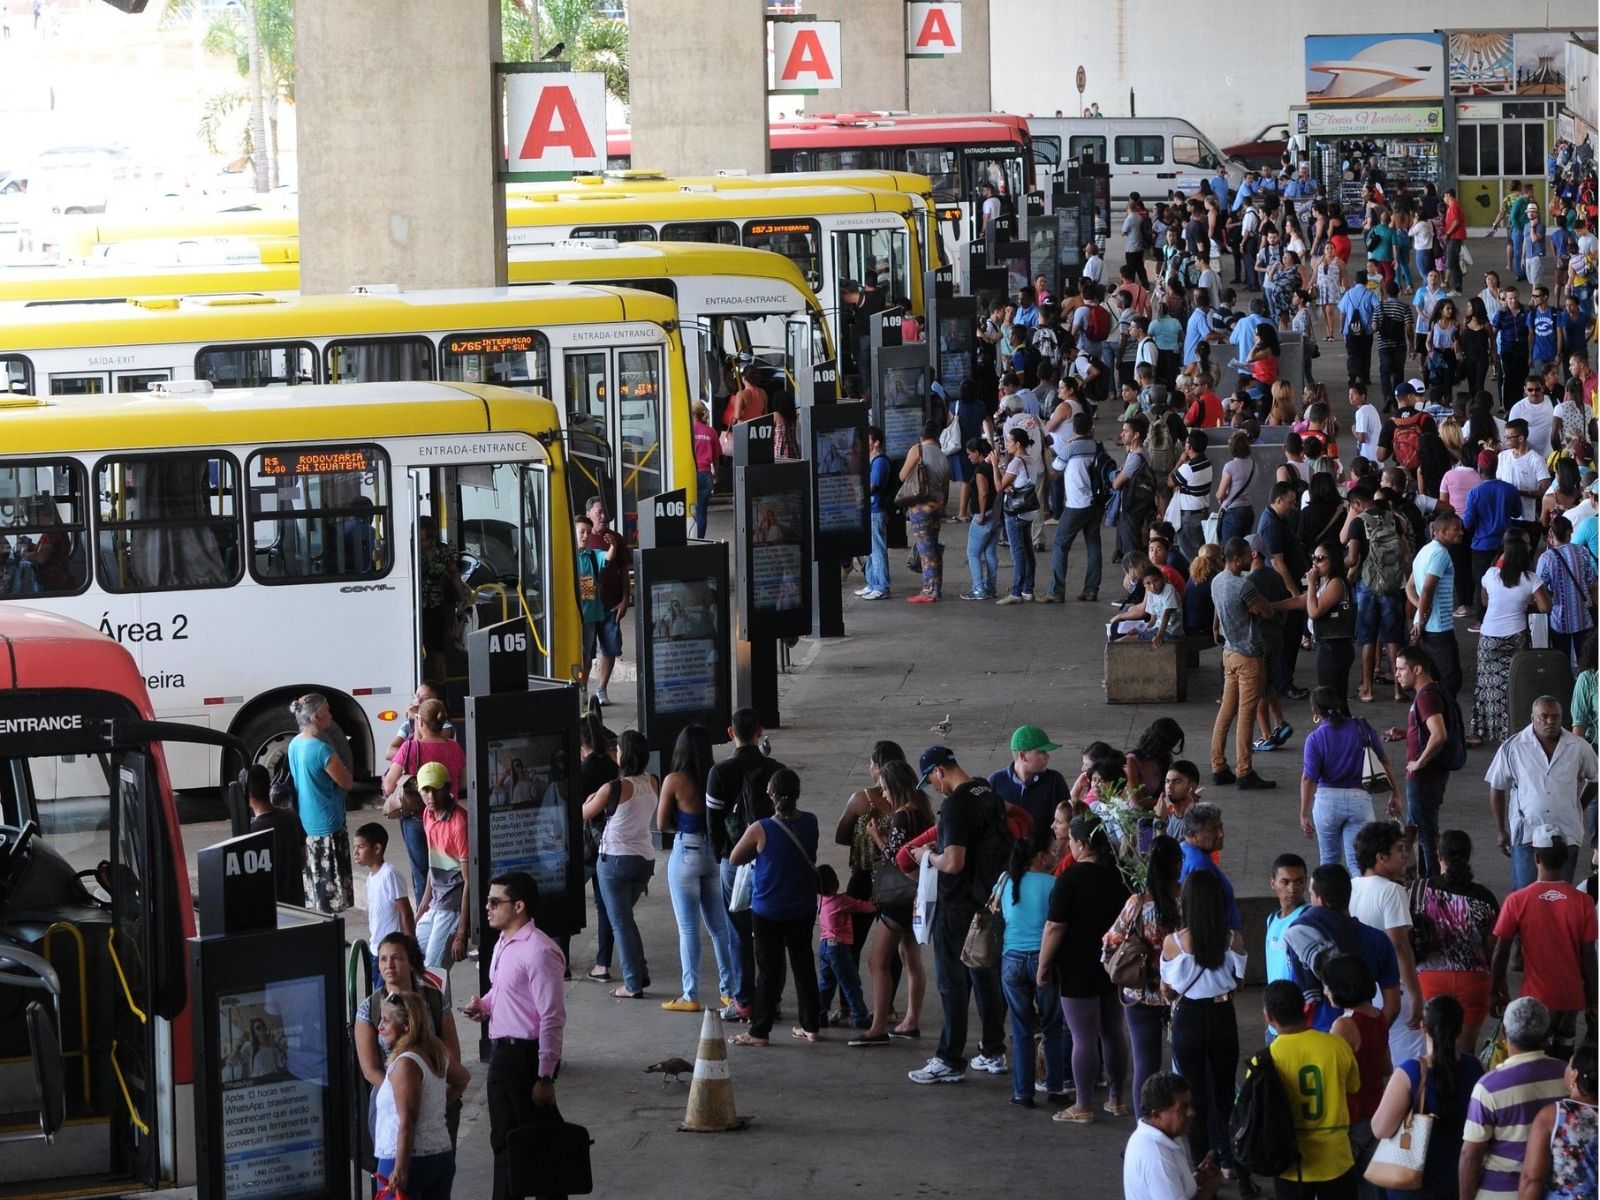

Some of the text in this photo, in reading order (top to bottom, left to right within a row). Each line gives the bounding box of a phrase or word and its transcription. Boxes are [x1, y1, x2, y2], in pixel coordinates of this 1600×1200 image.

[915, 8, 956, 47] A
[781, 29, 834, 80] A
[519, 85, 597, 160] A
[705, 295, 788, 305] ENTRADA-ENTRANCE
[882, 315, 902, 328] A 09
[572, 328, 656, 341] ENTRADA-ENTRANCE
[814, 369, 836, 383] A 08
[749, 425, 772, 440] A 07
[418, 440, 528, 456] ENTRADA-ENTRANCE
[299, 453, 364, 464] RODOVIARIA
[655, 501, 685, 517] A 06
[99, 611, 189, 643] Área 2
[489, 632, 527, 653] A 05
[225, 849, 273, 876] A 04
[1299, 1064, 1324, 1121] 9
